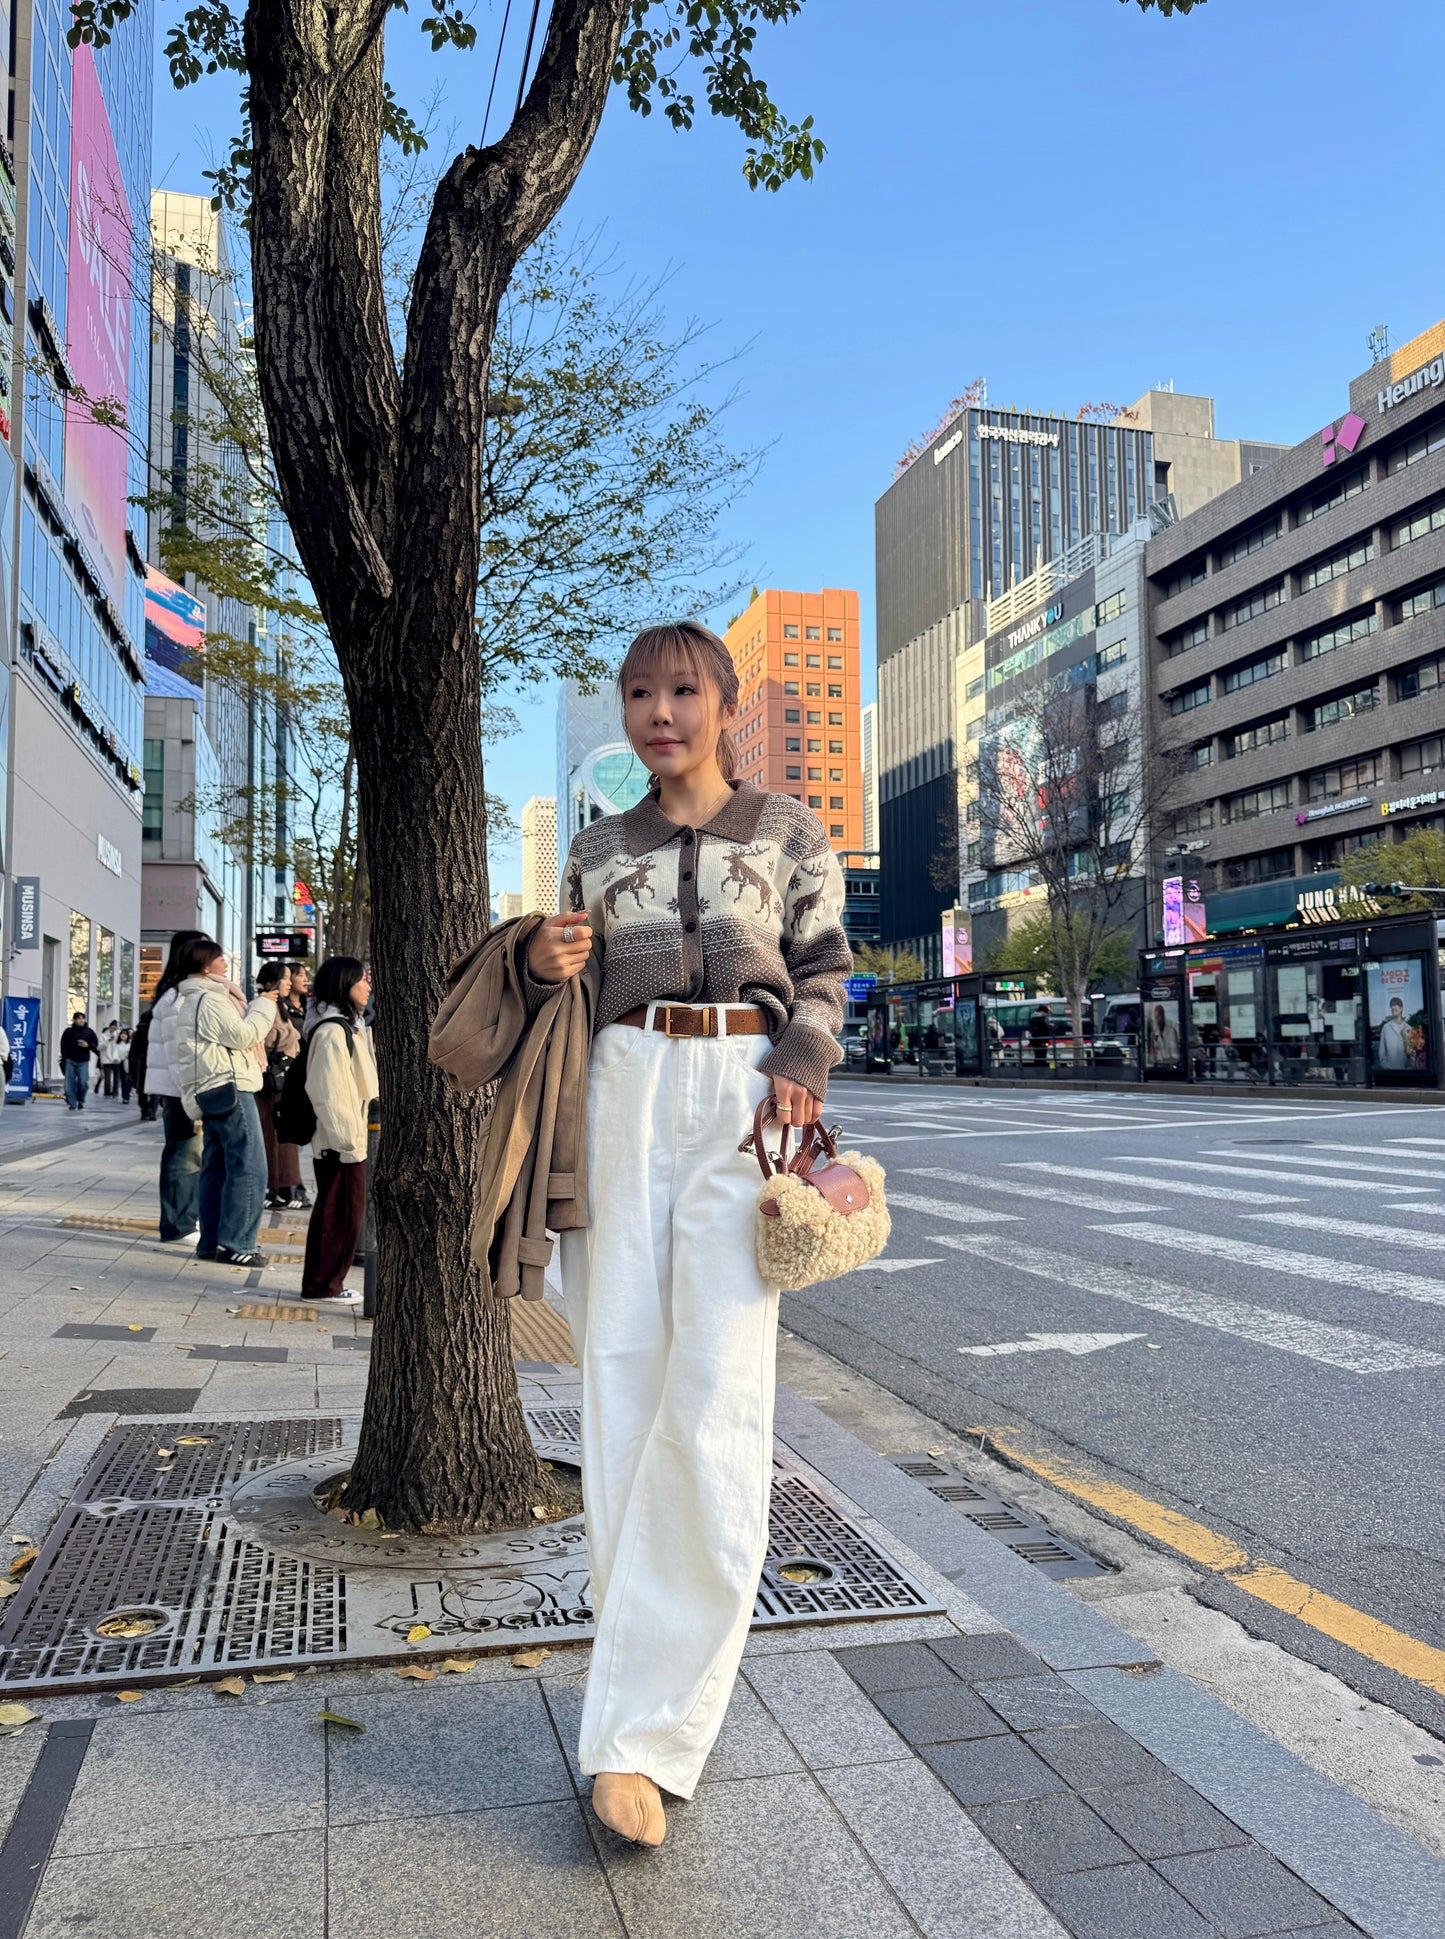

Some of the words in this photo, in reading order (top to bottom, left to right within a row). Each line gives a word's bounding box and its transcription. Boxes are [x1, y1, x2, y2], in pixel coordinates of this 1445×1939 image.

[1378, 350, 1445, 413] Heung
[21, 885, 34, 940] MUSINSA
[1296, 887, 1335, 911] JUNO
[10, 1004, 29, 1066] 을지포차
[437, 1546, 480, 1559] to
